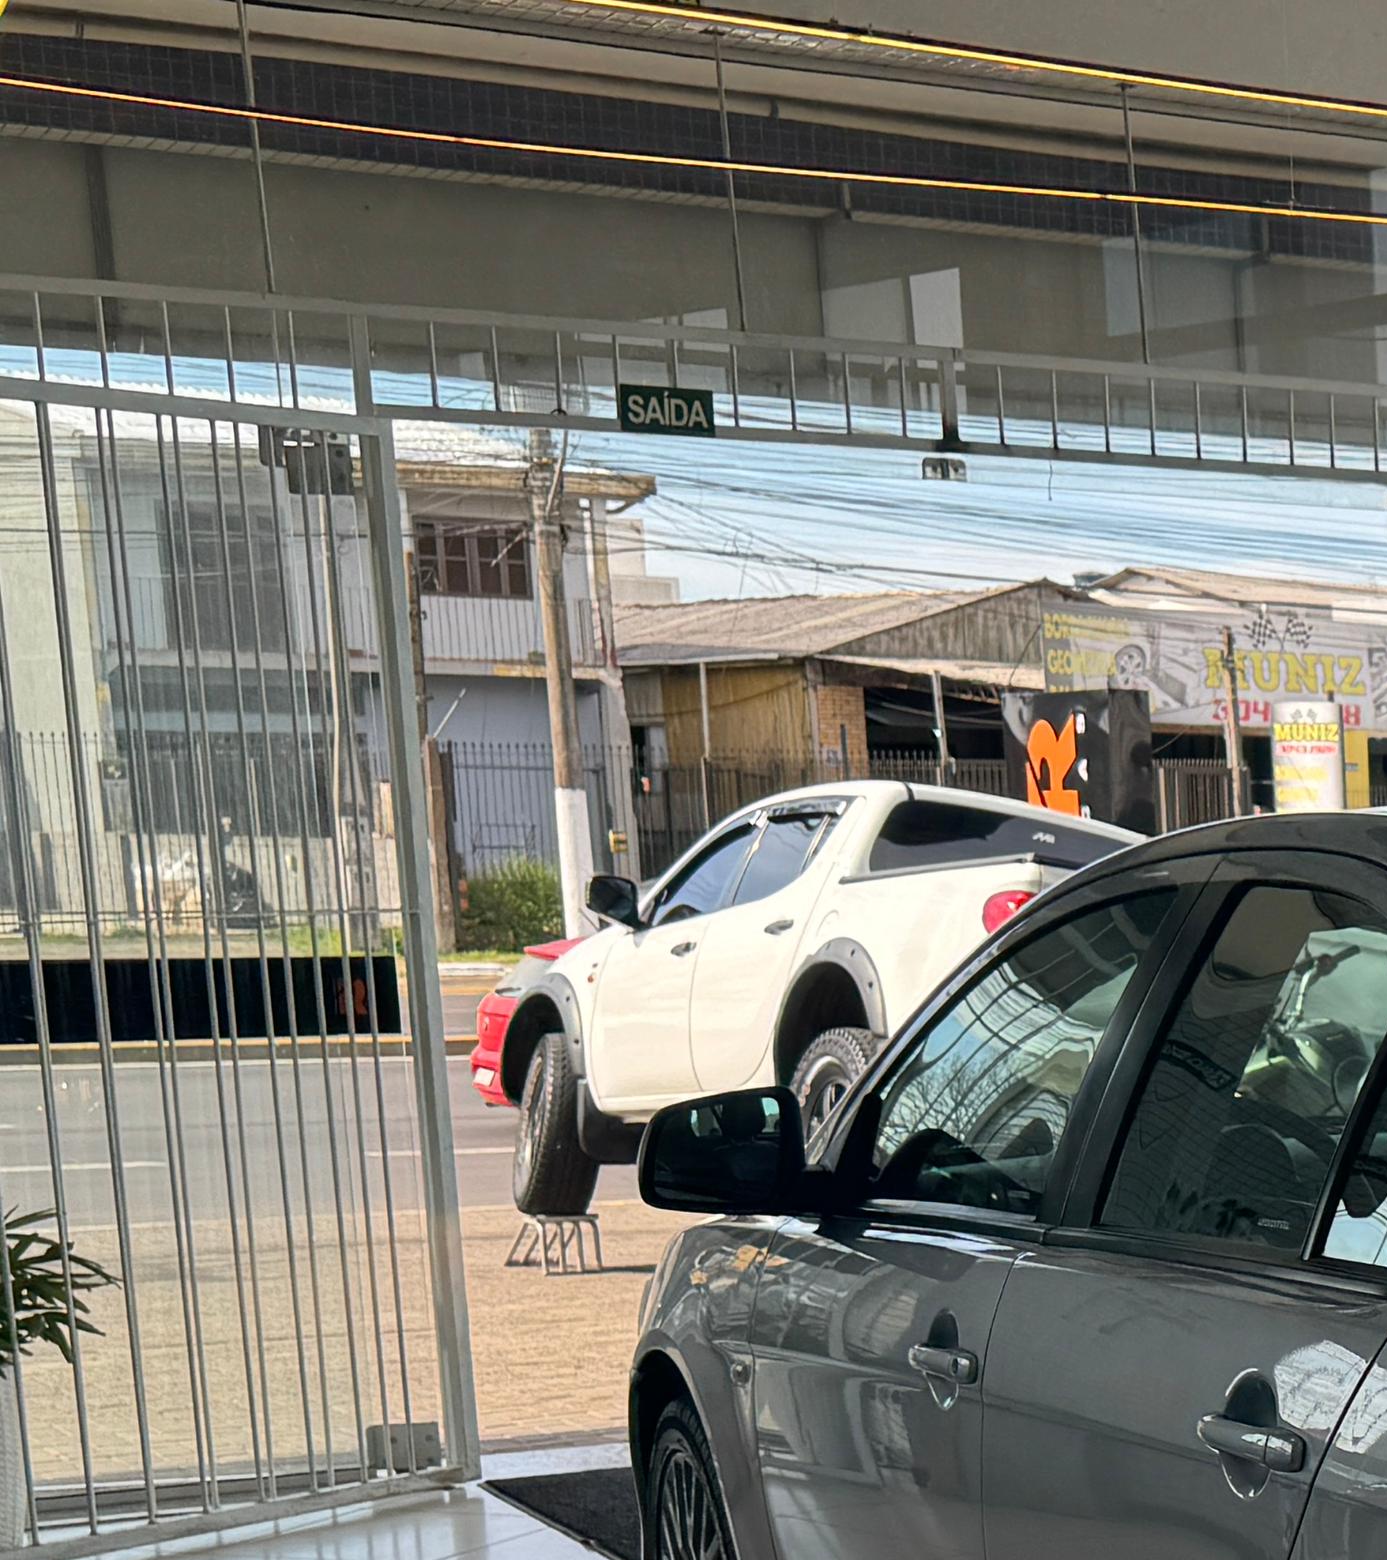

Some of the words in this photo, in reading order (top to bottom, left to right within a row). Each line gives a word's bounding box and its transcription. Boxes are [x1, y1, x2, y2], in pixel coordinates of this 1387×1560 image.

[627, 390, 709, 429] SAÍDA
[1202, 647, 1367, 695] MUNIZ
[1273, 723, 1340, 742] MUNIZ
